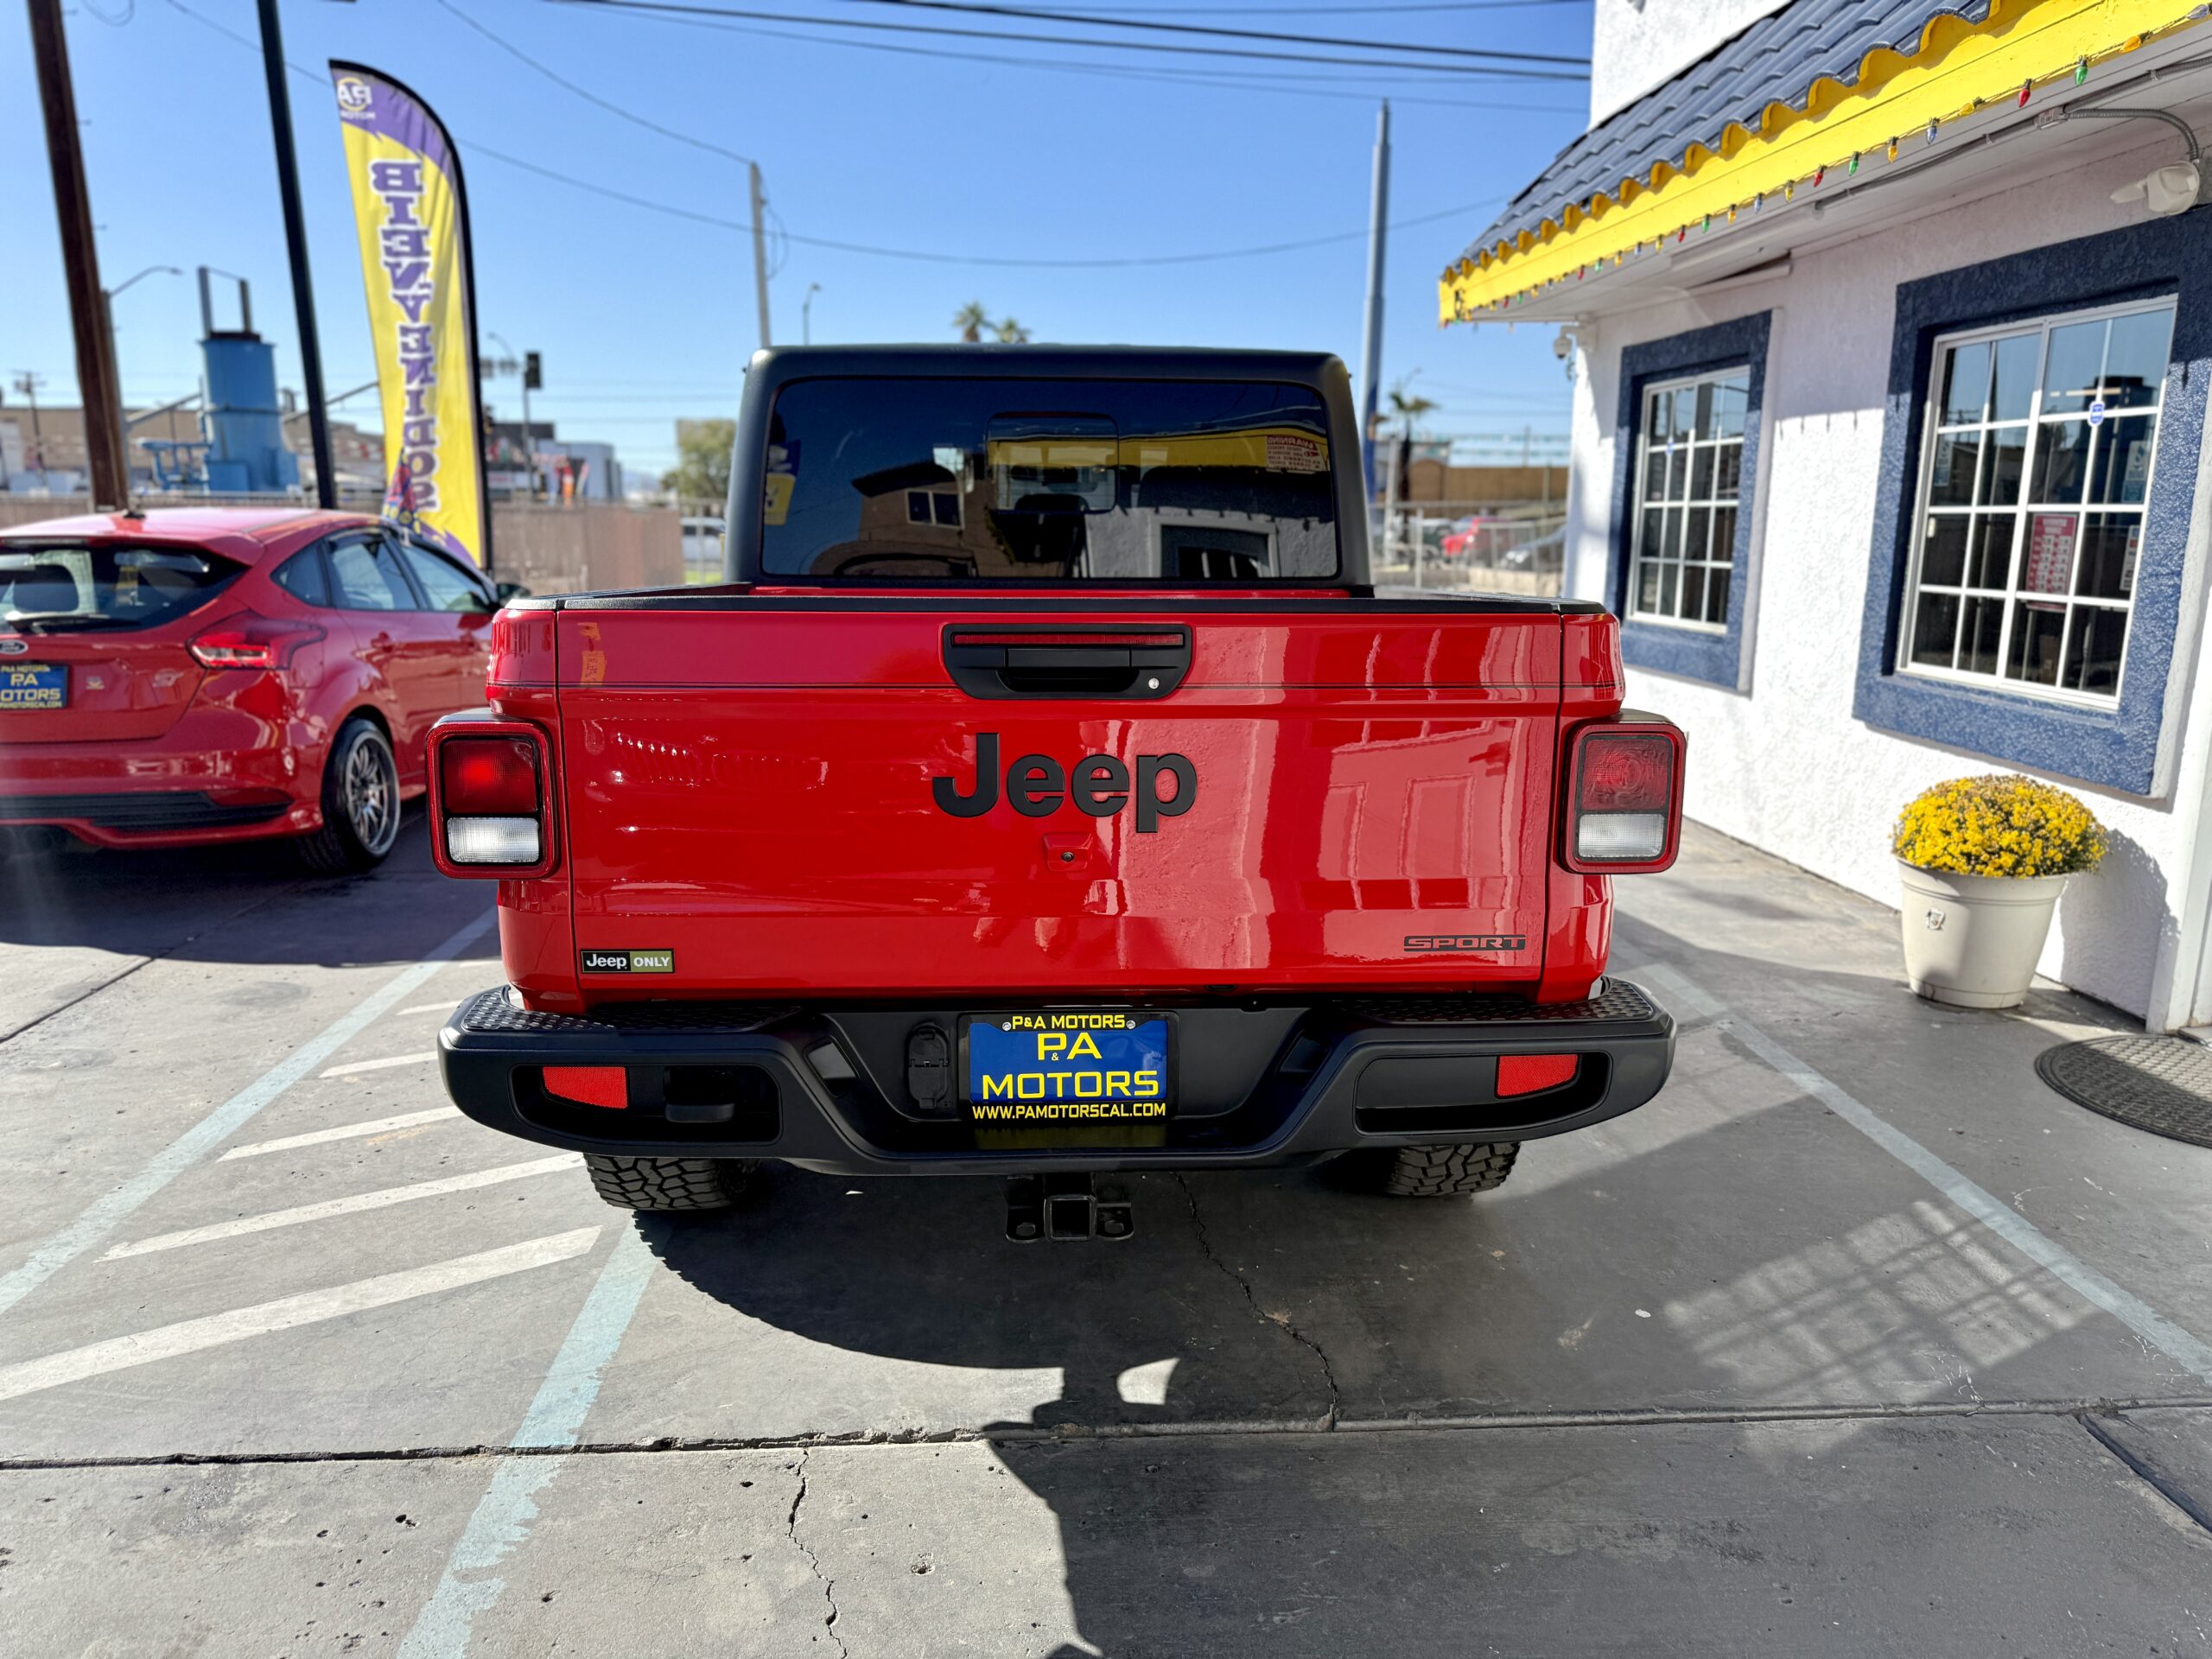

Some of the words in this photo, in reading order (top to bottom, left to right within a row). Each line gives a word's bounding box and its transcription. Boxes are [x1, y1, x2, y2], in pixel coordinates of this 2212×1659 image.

[0, 688, 60, 702] OTORS
[932, 733, 1198, 833] Jeep
[1405, 936, 1526, 950] SPORT
[586, 953, 627, 969] Jeep
[633, 957, 671, 967] ONLY
[1012, 1015, 1046, 1030] P&A
[1052, 1014, 1126, 1029] MOTORS
[982, 1071, 1159, 1100] MOTORS
[972, 1103, 1166, 1119] WWW.PAMOTORSCAL.COM
